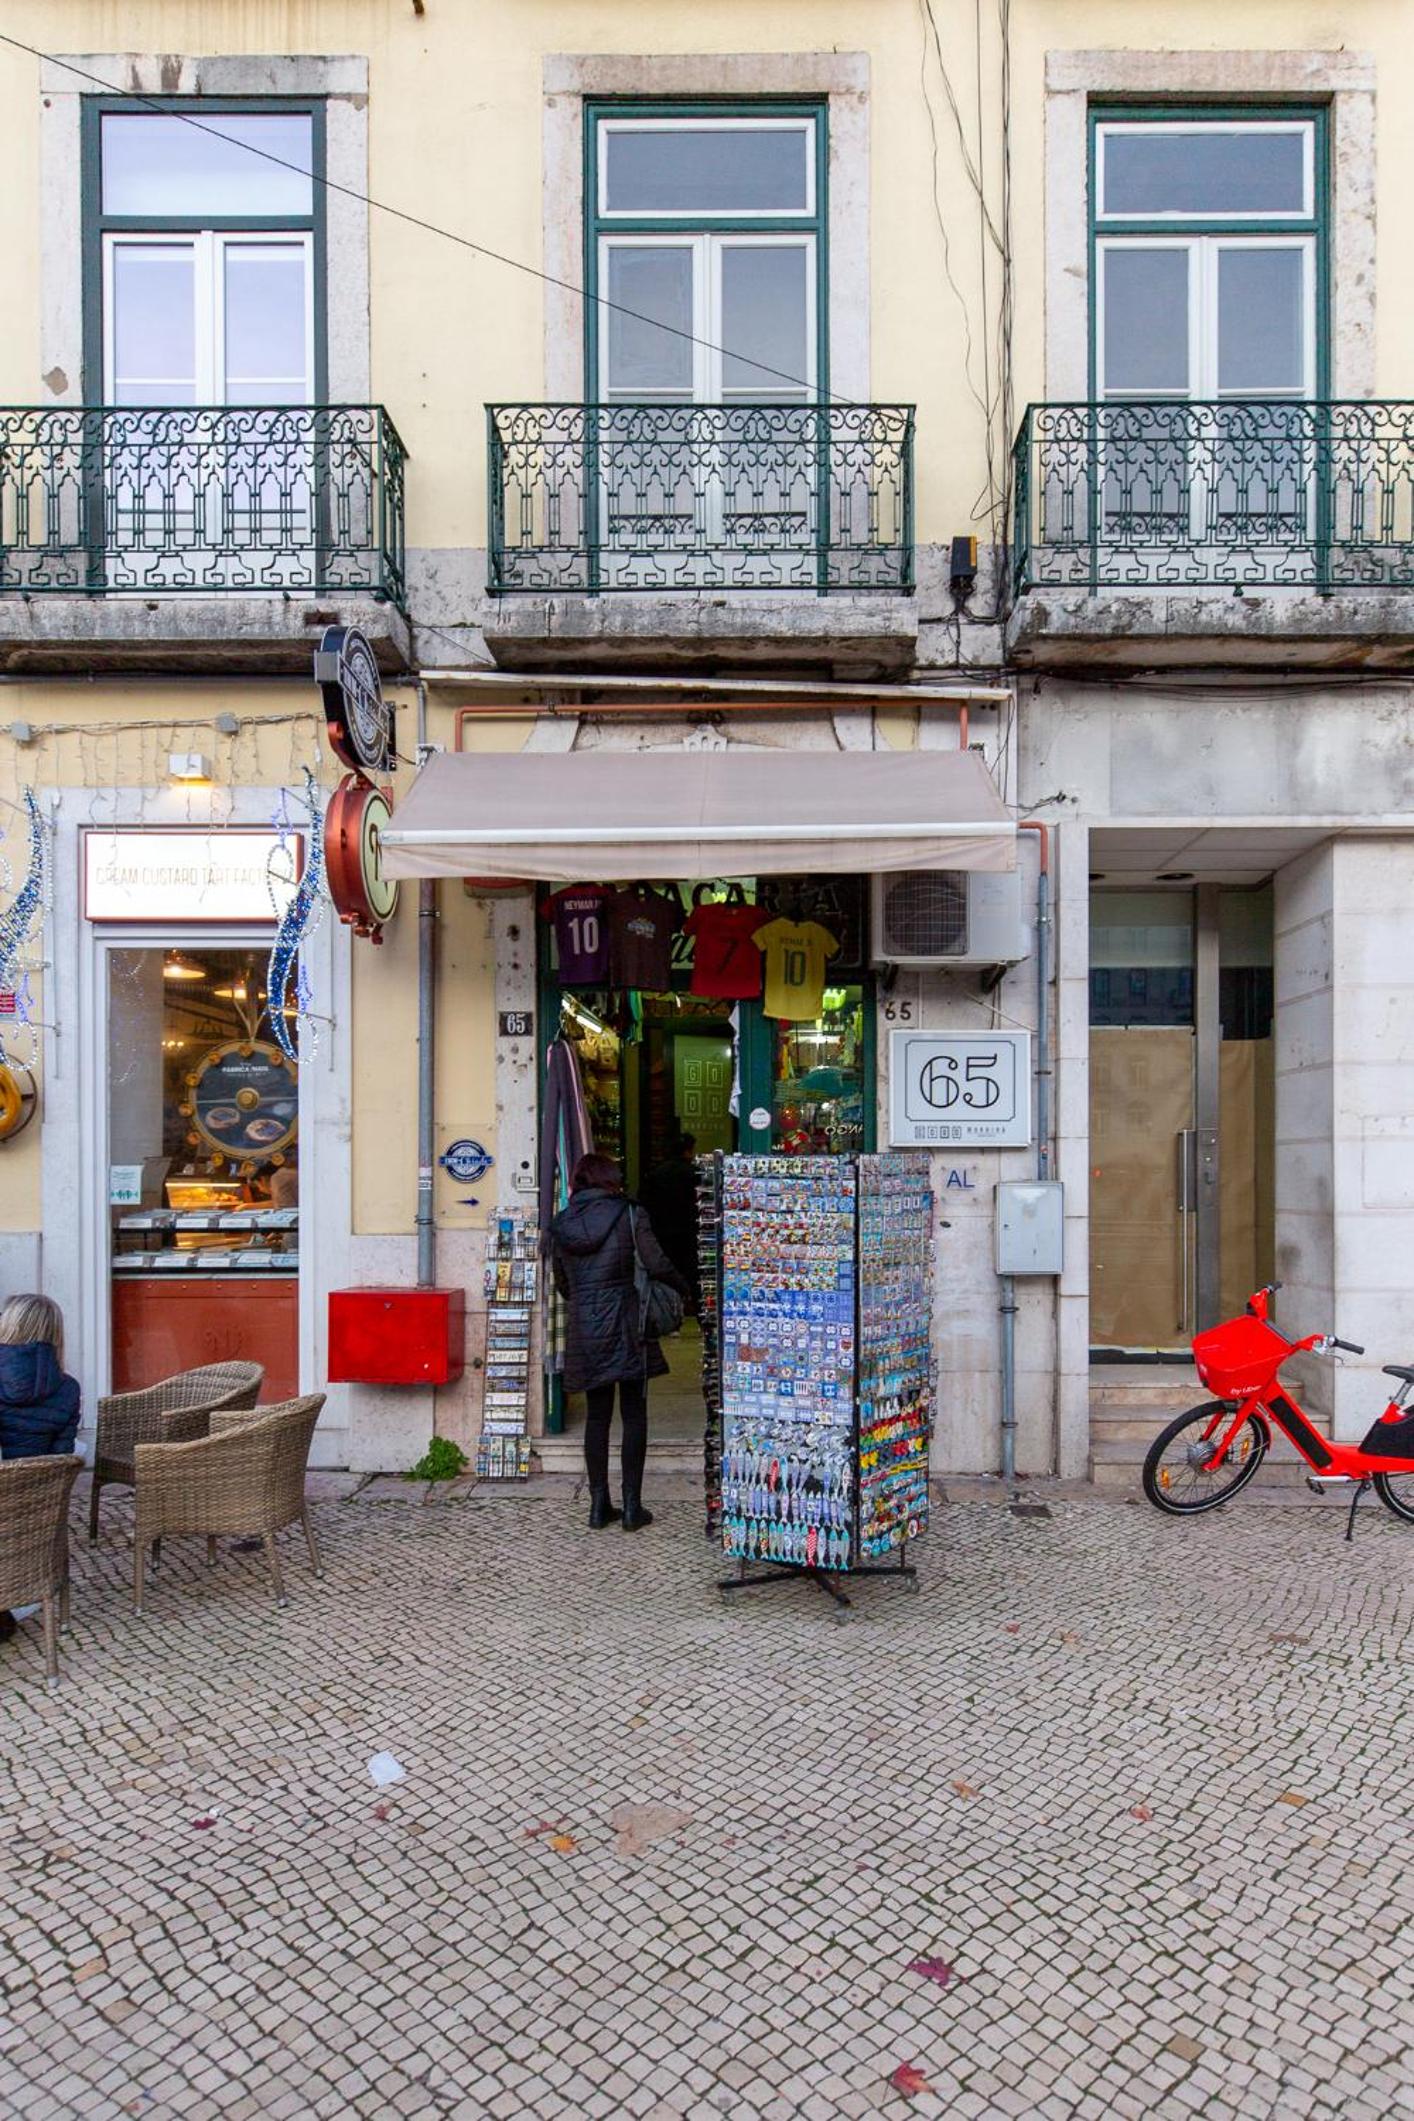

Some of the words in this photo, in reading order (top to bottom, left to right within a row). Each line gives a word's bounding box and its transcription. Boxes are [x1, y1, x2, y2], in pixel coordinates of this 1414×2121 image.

[96, 867, 138, 885] CREAM
[143, 867, 197, 885] CUSTARD
[568, 916, 599, 955] 10
[717, 938, 739, 974] 7
[784, 948, 807, 986] 10
[506, 1013, 525, 1034] 65
[885, 1002, 912, 1020] 65
[920, 1053, 1000, 1108] 65
[947, 1170, 975, 1188] AL
